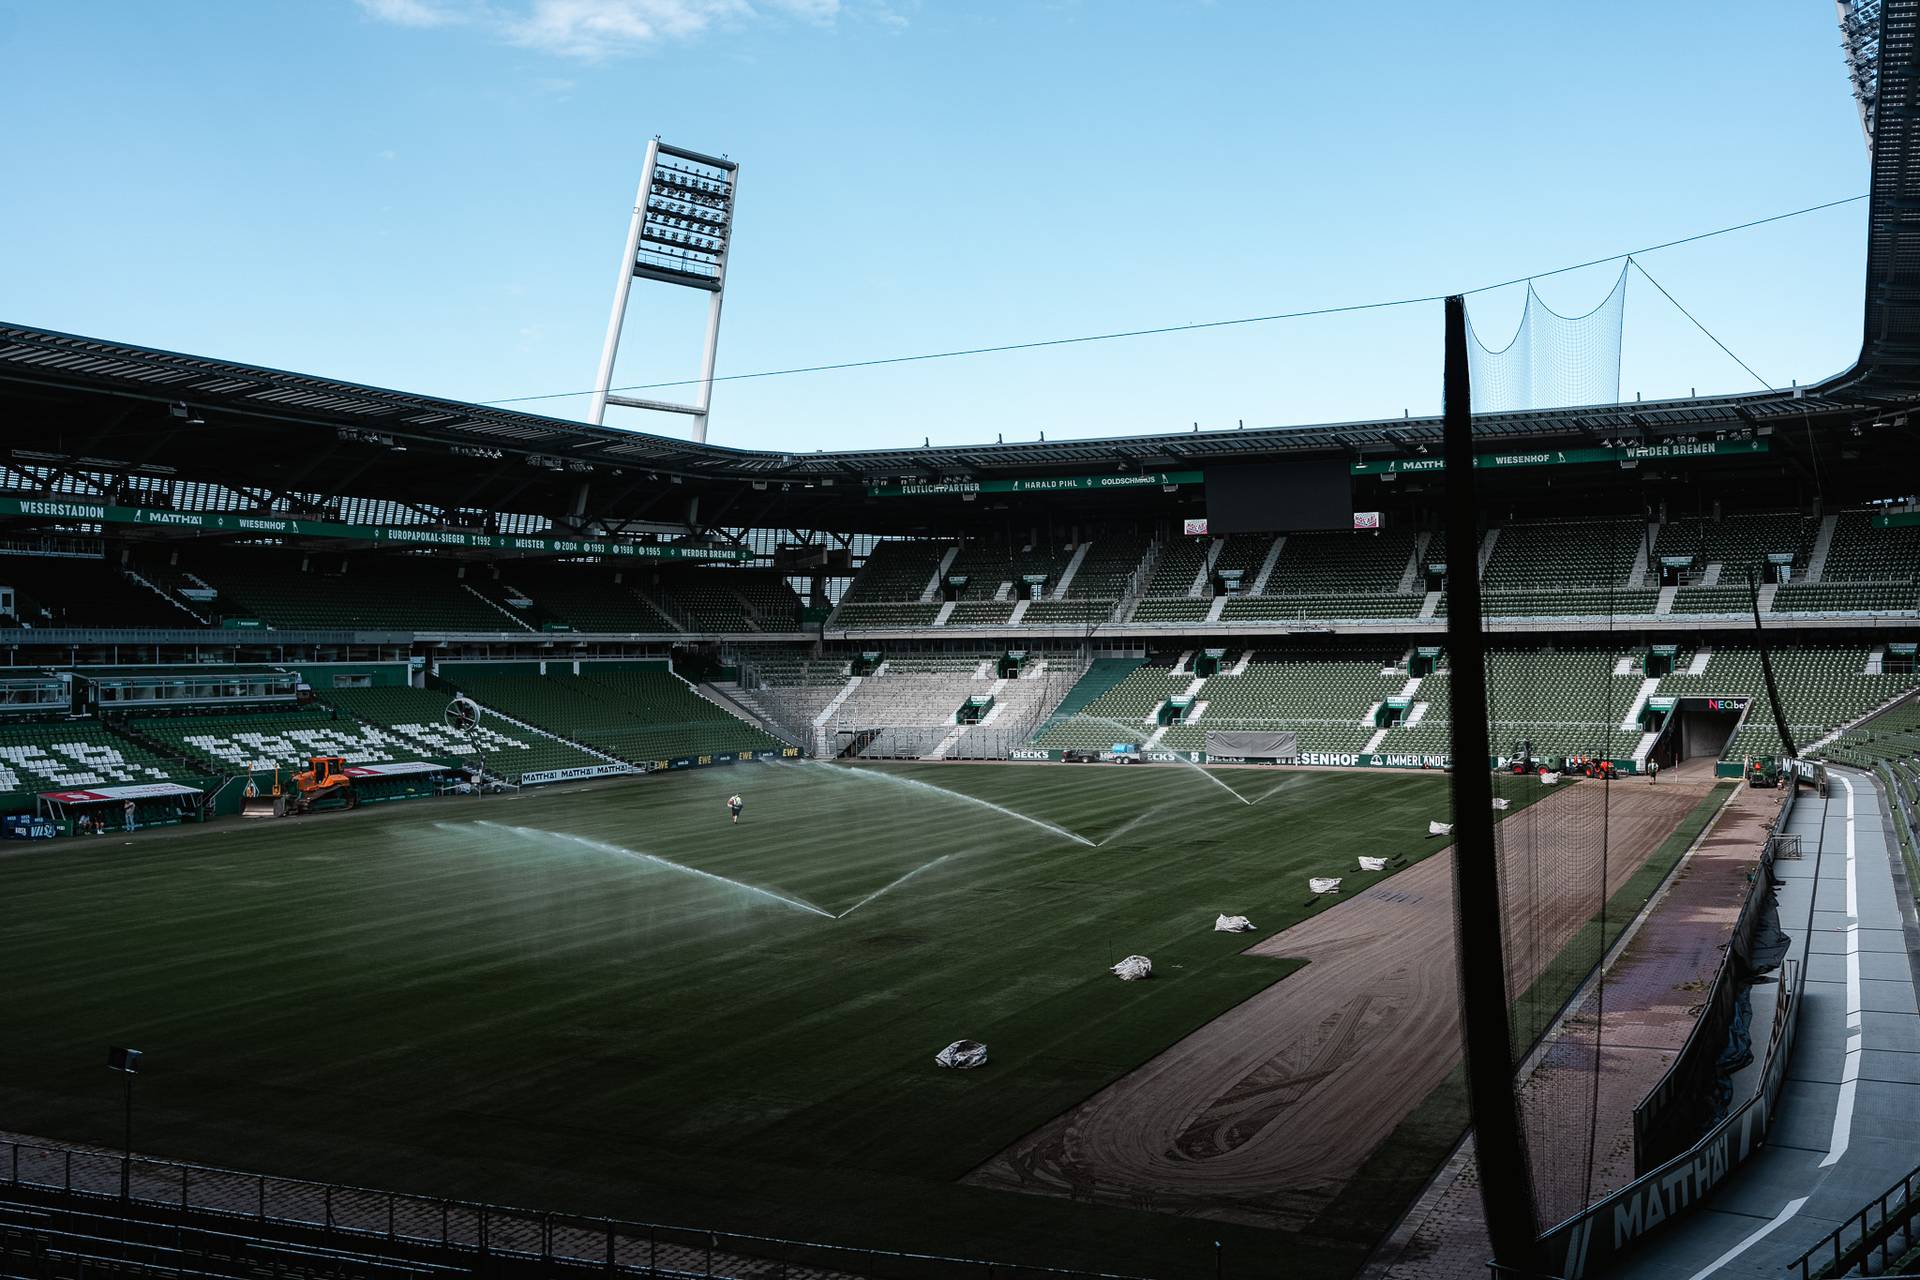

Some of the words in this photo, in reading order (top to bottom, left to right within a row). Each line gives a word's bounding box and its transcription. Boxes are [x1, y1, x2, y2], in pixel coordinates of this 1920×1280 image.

[1626, 445, 1669, 458] WERDER
[1672, 442, 1716, 455] BREMEN
[1402, 460, 1447, 470] MATTH
[1495, 454, 1551, 465] WIESENHOF
[1024, 481, 1057, 489] HARALD
[1058, 479, 1078, 488] PIHL
[20, 501, 104, 519] WESERSTADION
[239, 519, 286, 531] WIESENHOF
[388, 529, 465, 544] EUROPAPOKAL-SIEGER
[477, 535, 491, 546] 1992
[515, 539, 545, 550] MEISTER
[561, 541, 577, 551] 2004
[591, 543, 605, 553] 1993
[646, 546, 661, 556] 1965
[681, 548, 709, 558] WERDER
[709, 549, 736, 559] BREMEN
[739, 751, 753, 761] EWE
[782, 747, 799, 757] EWE
[1013, 750, 1049, 759] BECK'S
[698, 755, 712, 765] EWE
